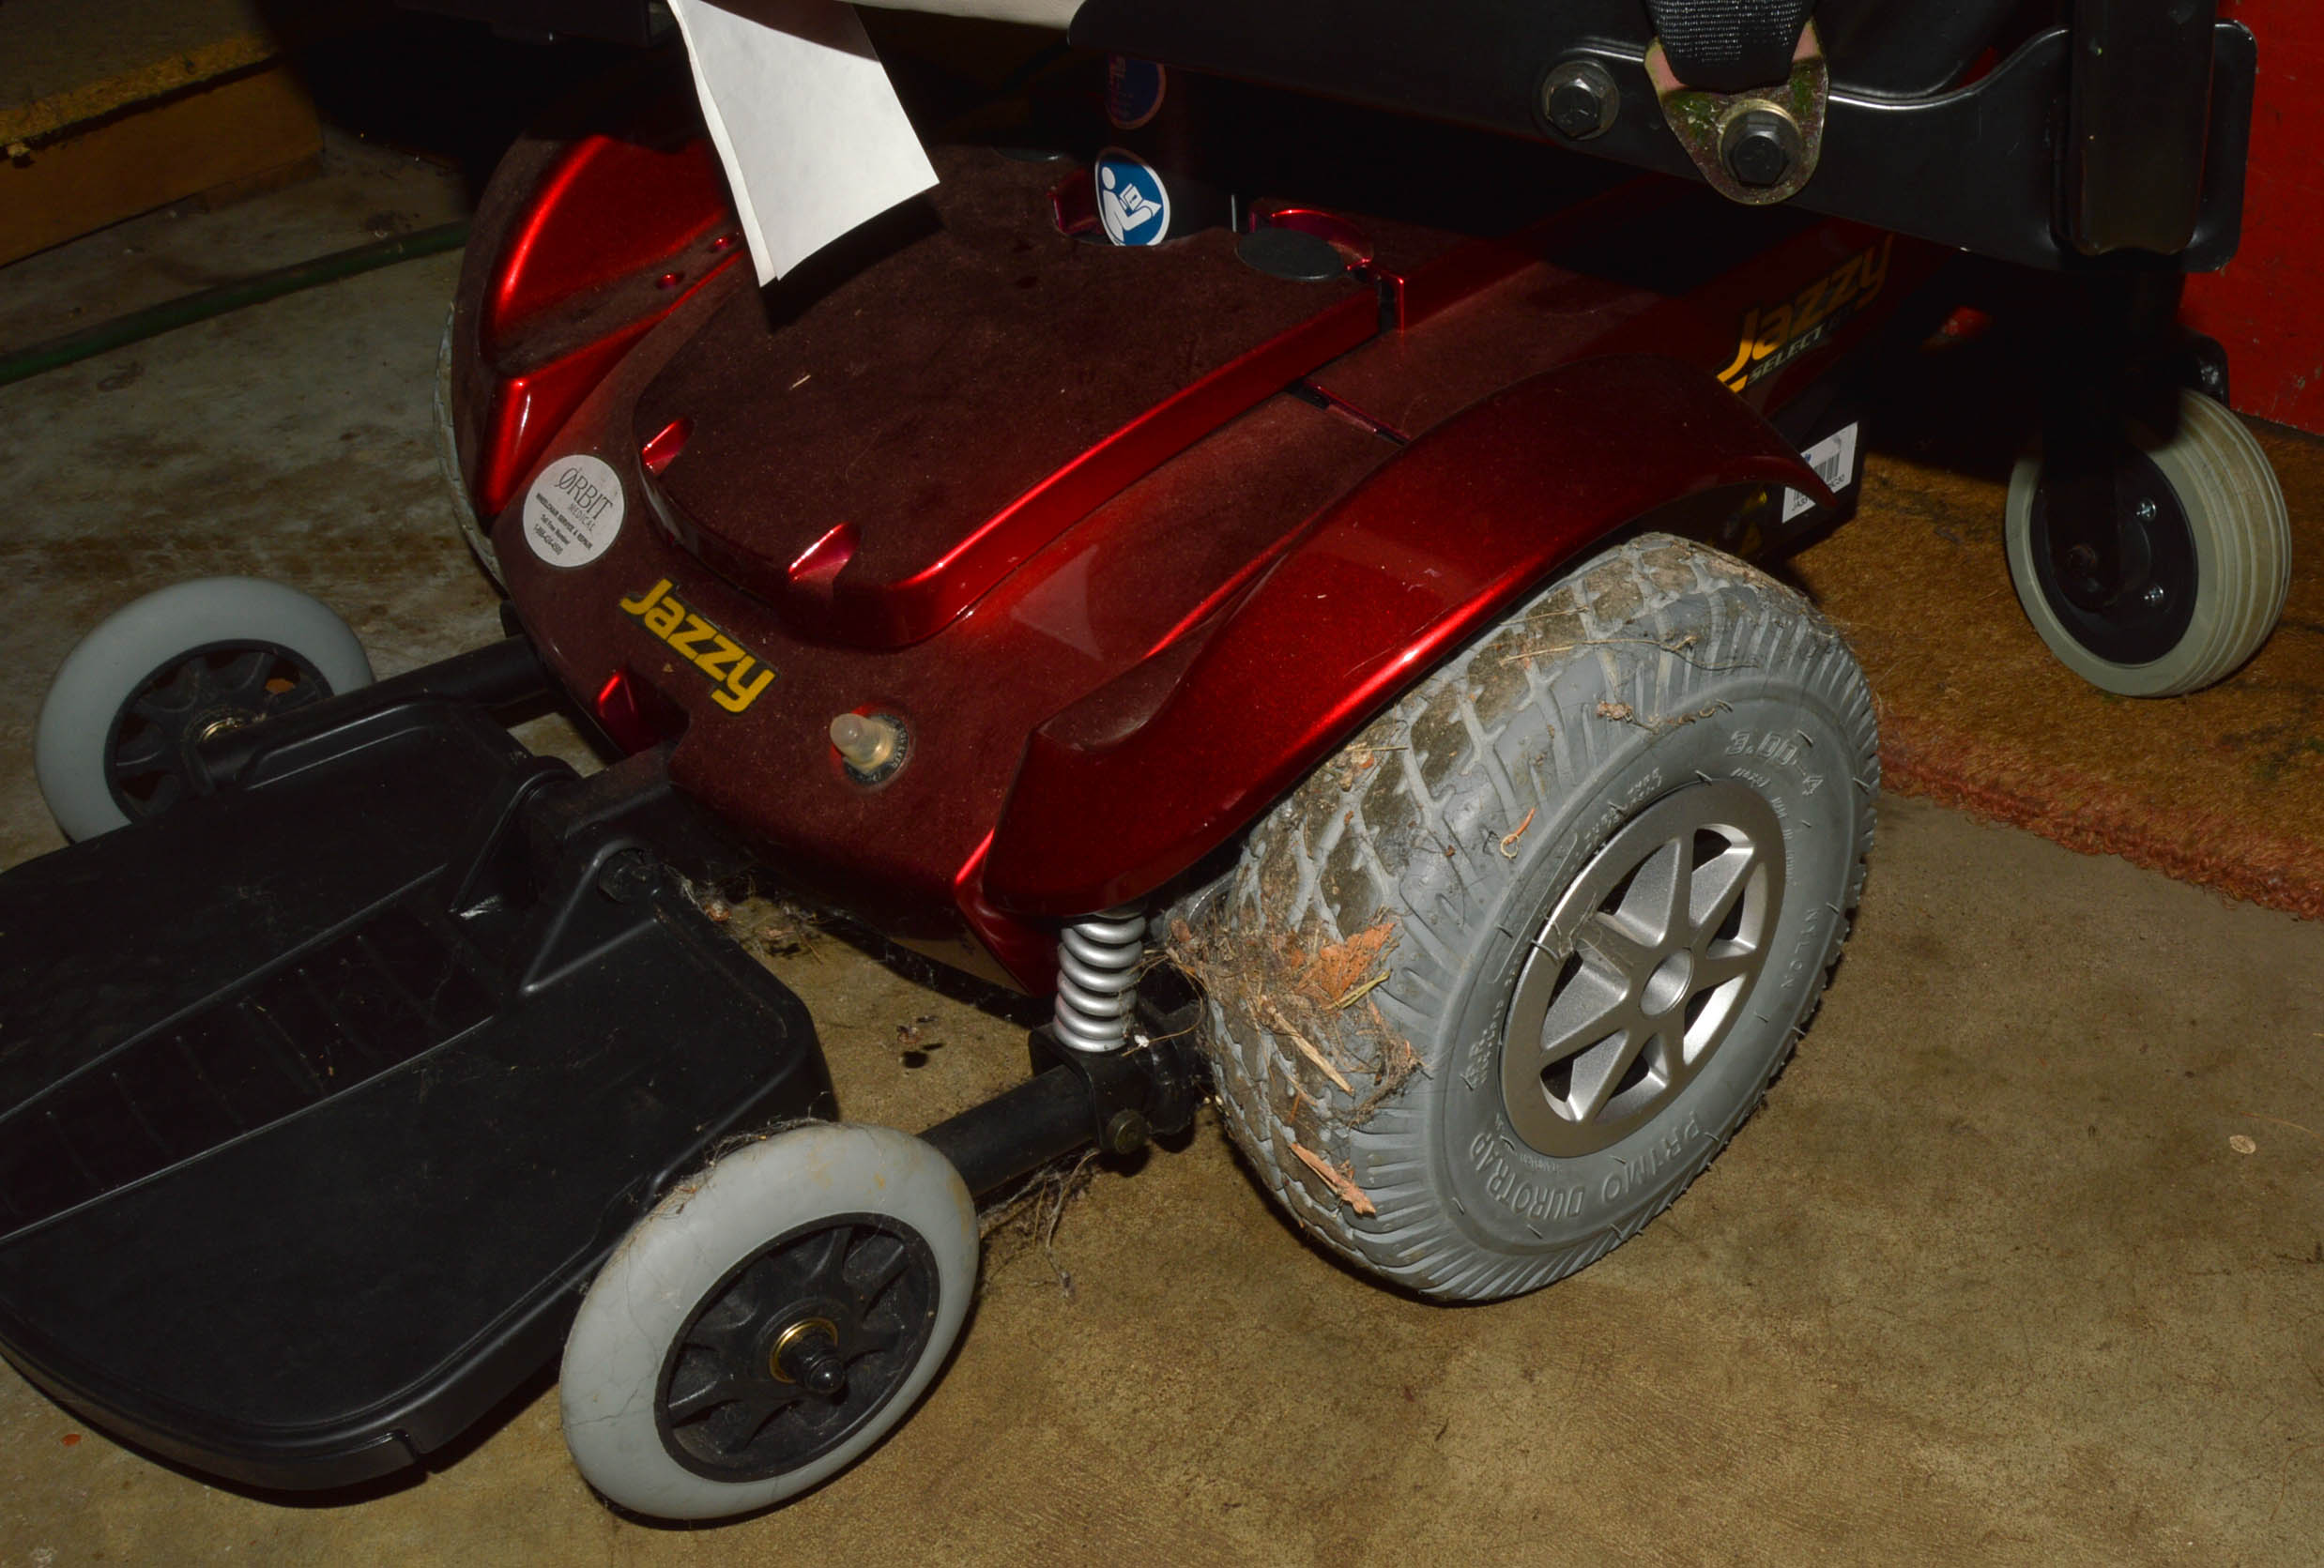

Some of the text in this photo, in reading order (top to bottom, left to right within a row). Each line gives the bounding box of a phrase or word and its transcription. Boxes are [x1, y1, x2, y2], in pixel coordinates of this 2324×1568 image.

[1716, 233, 1895, 383] Jazzy
[1749, 324, 1824, 384] SELECT
[570, 503, 596, 531] MEDICAL
[619, 578, 775, 712] Jazzy
[1781, 906, 1819, 990] NYLON
[1469, 1110, 1702, 1221] PRIMO DUROTRAP
